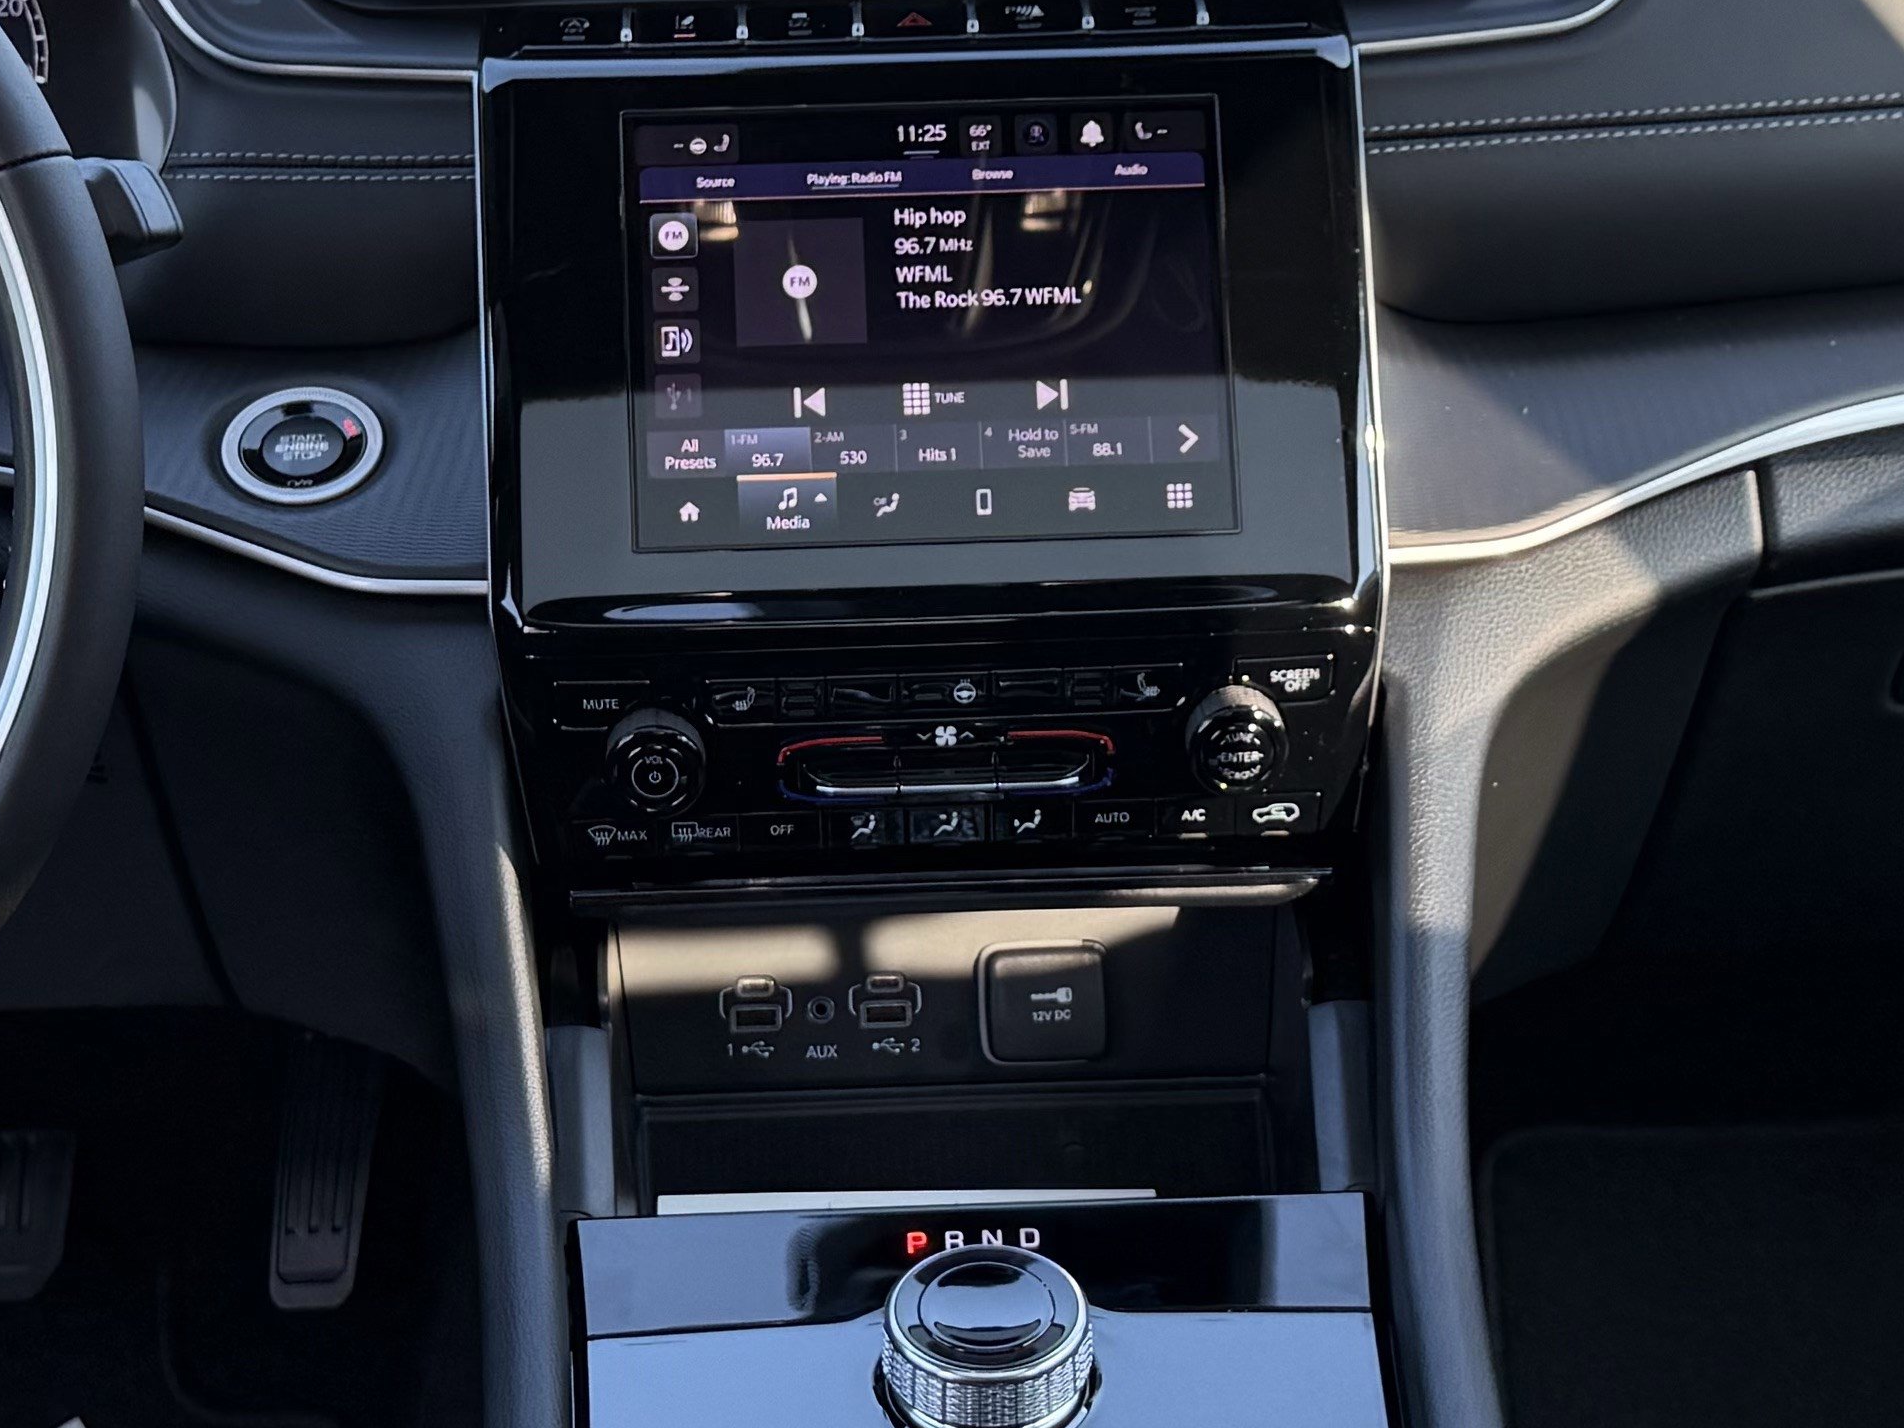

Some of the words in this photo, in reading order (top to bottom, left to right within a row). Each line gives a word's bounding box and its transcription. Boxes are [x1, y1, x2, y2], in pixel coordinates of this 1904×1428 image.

[897, 124, 947, 142] 11:25
[971, 169, 1014, 181] Browse
[1114, 163, 1148, 176] Audio
[696, 176, 736, 189] Source
[851, 172, 883, 184] Radio
[884, 171, 902, 183] FM
[894, 208, 927, 229] Hip
[930, 207, 966, 228] hop
[664, 231, 683, 240] FM
[894, 237, 936, 255] 96.7
[939, 238, 973, 252] MHz
[790, 276, 811, 287] FM
[895, 266, 953, 283] WFML
[897, 291, 931, 309] The
[935, 289, 980, 308] Rock
[981, 287, 1023, 307] 96.7
[1025, 286, 1082, 305] WFML
[934, 392, 965, 404] TUNE
[280, 433, 325, 443] START
[814, 432, 845, 443] 2-AM
[900, 429, 908, 441] 3
[984, 426, 993, 437] 4
[1008, 428, 1041, 442] Hold
[1043, 428, 1059, 441] to
[681, 438, 699, 452] All
[730, 433, 758, 445] 1-FM
[274, 441, 329, 453] ENGINE
[1018, 444, 1051, 458] Save
[1092, 442, 1123, 457] 88.1
[752, 453, 784, 468] 96.7
[840, 450, 868, 465] 530
[918, 447, 947, 462] Hits
[950, 447, 957, 461] 1
[664, 455, 717, 471] Presets
[766, 515, 811, 530] Media
[1270, 668, 1320, 682] SCREEN
[1283, 679, 1311, 693] OFF
[582, 698, 620, 711] MUTE
[644, 756, 664, 766] VOL
[1095, 811, 1130, 824] AUTO
[1181, 808, 1206, 822] A/C
[617, 828, 648, 842] MAX
[697, 826, 731, 839] REAR
[770, 824, 794, 836] OFF
[1032, 1011, 1052, 1021] 12V
[1054, 1009, 1072, 1020] DC
[727, 1043, 734, 1057] 1
[805, 1044, 838, 1059] AUX
[910, 1038, 921, 1053] 2
[906, 1231, 928, 1254] P
[944, 1230, 965, 1250] R
[981, 1228, 1003, 1246] N
[1019, 1227, 1041, 1249] D
